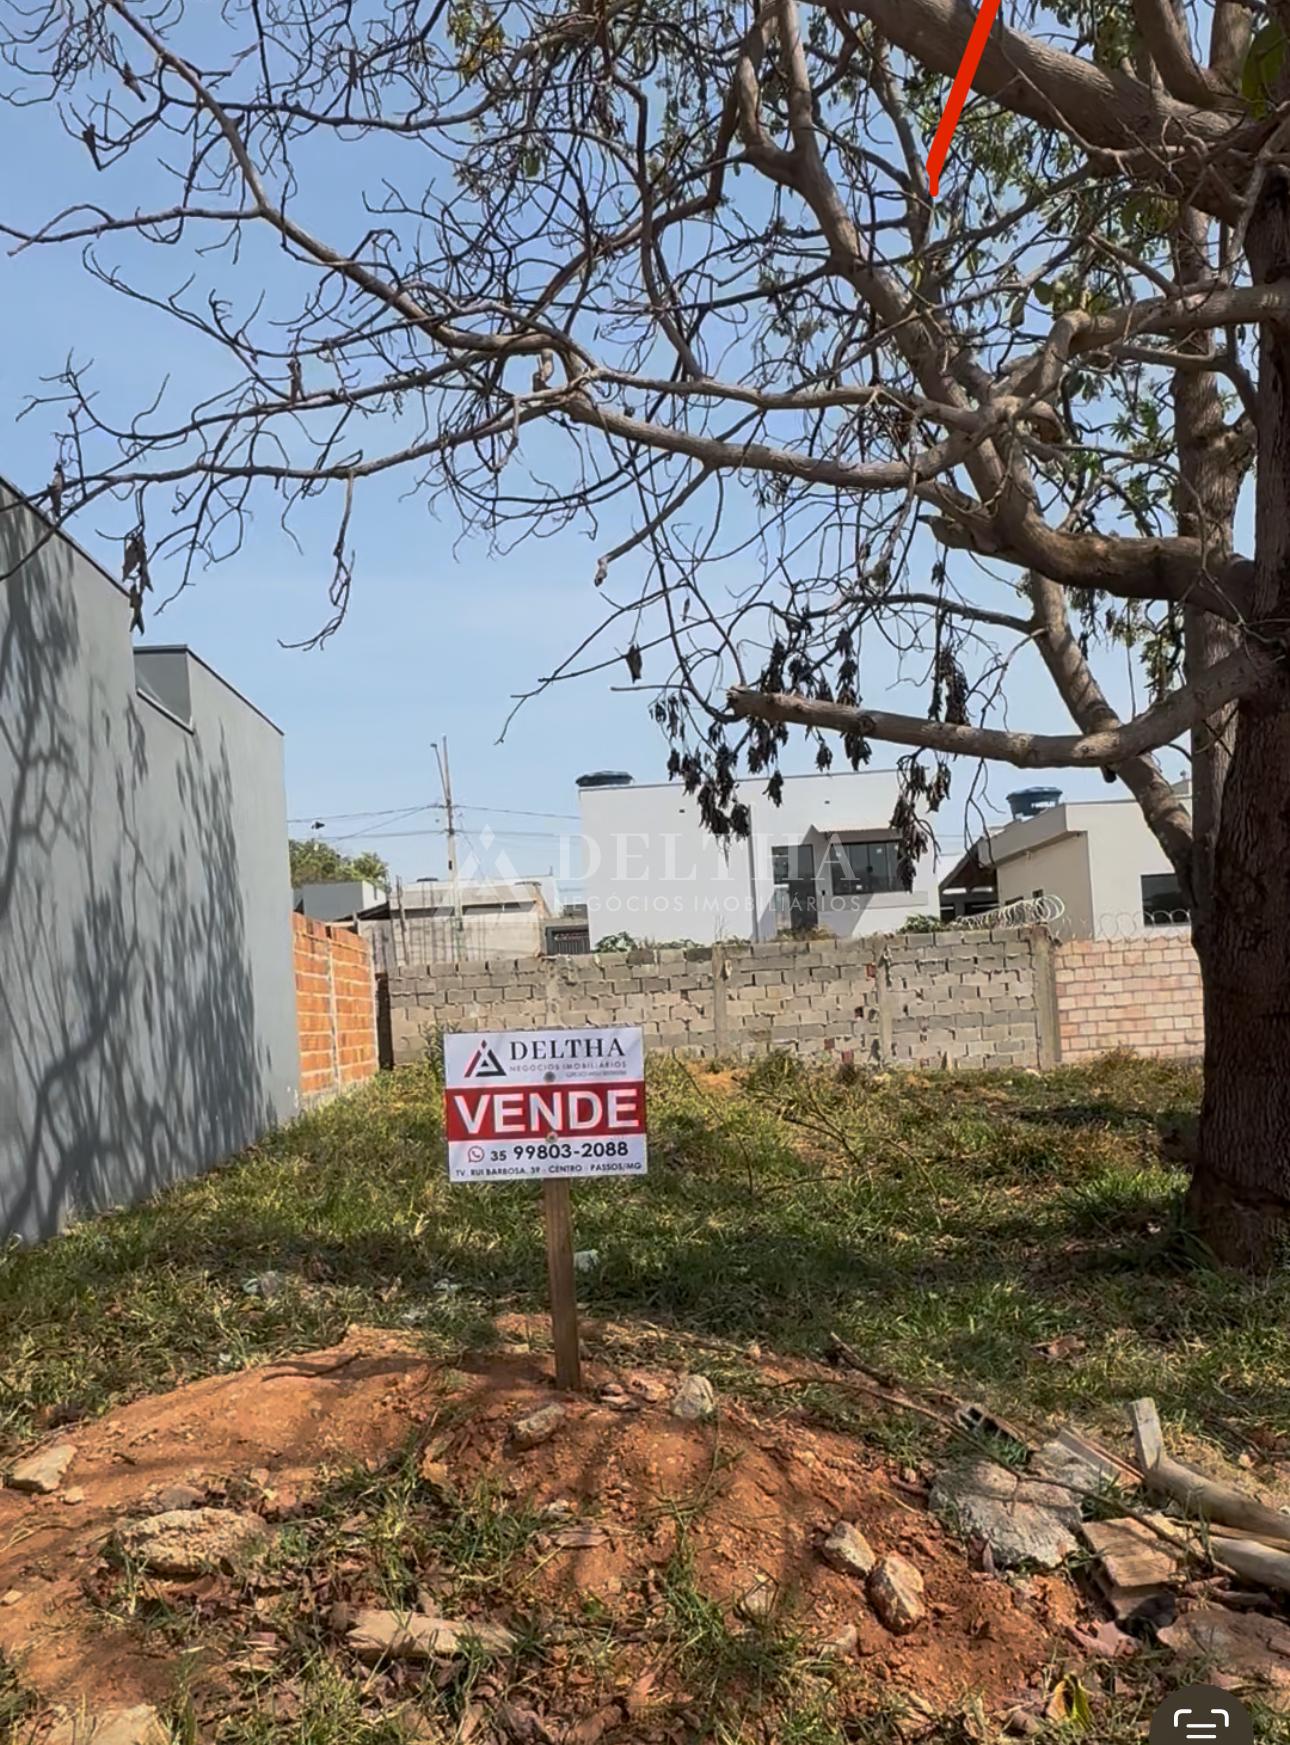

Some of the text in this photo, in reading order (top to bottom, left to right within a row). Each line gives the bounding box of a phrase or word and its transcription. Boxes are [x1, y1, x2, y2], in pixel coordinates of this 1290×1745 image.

[509, 1037, 626, 1061] DELTHA
[453, 1088, 640, 1135] VENDE
[490, 1141, 629, 1162] 35 99803-2088
[470, 1168, 484, 1176] RUI
[548, 1164, 583, 1174] CENTRO
